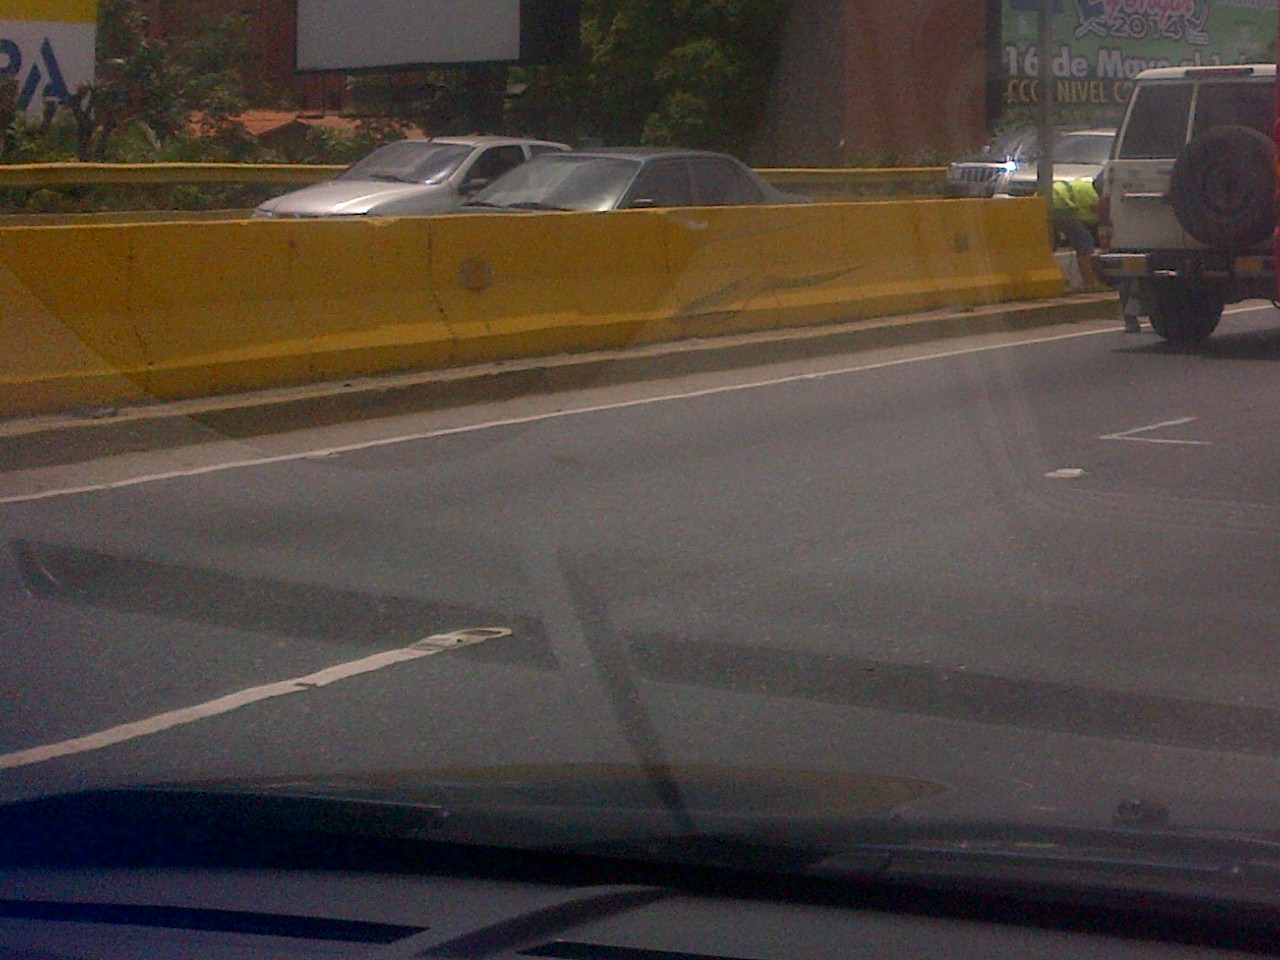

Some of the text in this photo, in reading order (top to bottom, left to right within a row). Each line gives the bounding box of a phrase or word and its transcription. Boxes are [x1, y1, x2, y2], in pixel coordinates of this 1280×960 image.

[1111, 12, 1182, 39] 2014
[1006, 46, 1039, 77] 16
[1052, 45, 1089, 77] de
[1057, 80, 1106, 103] NIVEL
